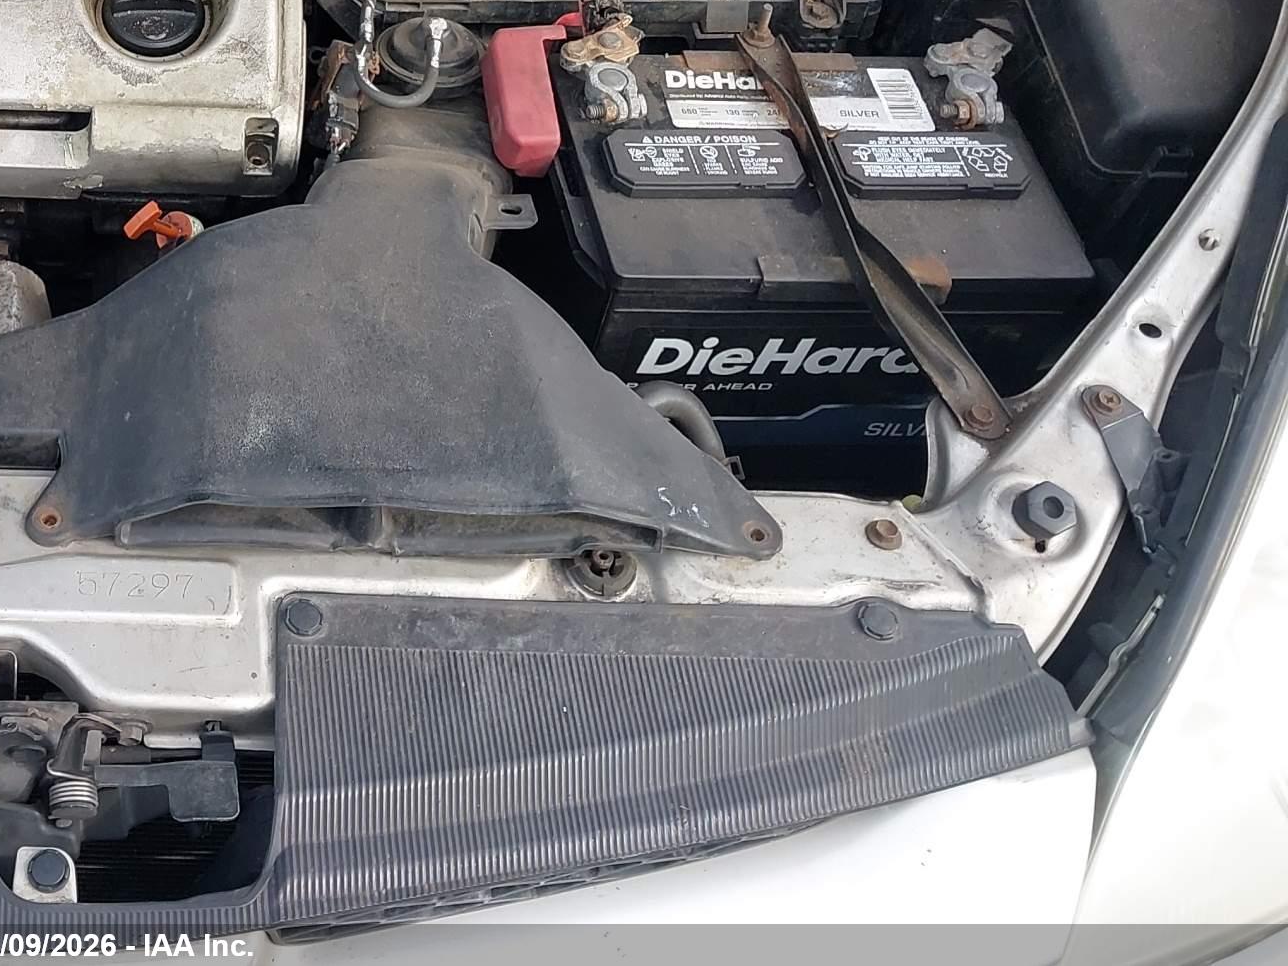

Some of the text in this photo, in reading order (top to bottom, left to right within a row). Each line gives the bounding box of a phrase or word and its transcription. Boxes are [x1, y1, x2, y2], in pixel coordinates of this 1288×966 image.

[839, 109, 880, 118] SILVER
[653, 135, 702, 143] DANGER
[713, 135, 757, 143] POISON
[702, 382, 773, 391] AHEAD
